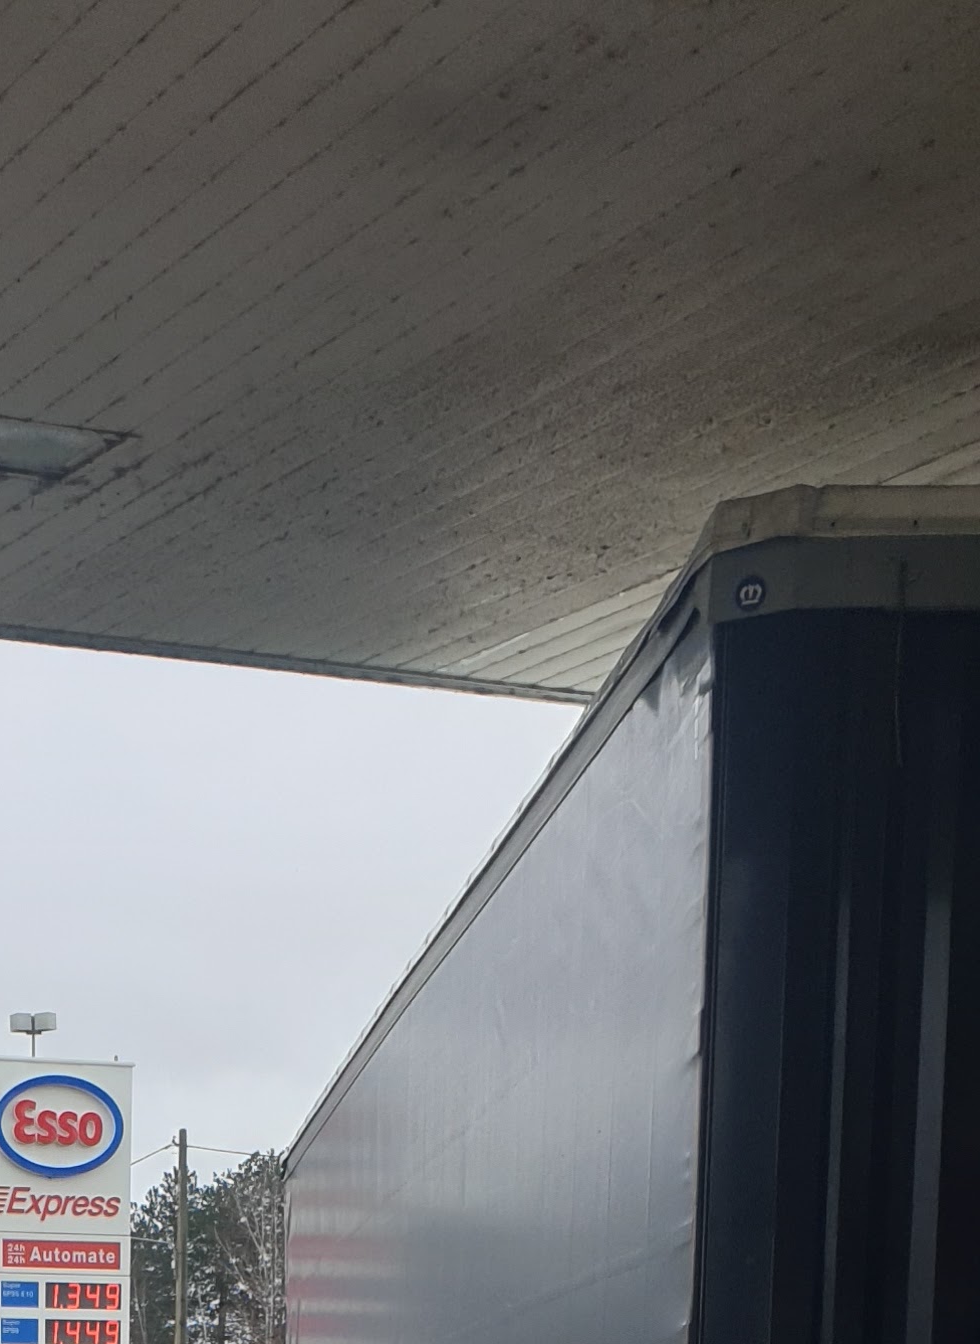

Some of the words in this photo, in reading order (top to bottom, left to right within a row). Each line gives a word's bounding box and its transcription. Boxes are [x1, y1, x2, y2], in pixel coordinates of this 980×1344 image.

[12, 1099, 103, 1147] Esso
[6, 1186, 122, 1221] Express
[7, 1243, 26, 1252] 24h
[7, 1255, 26, 1264] 24h
[29, 1246, 116, 1264] Automate
[52, 1283, 120, 1310] 1.349
